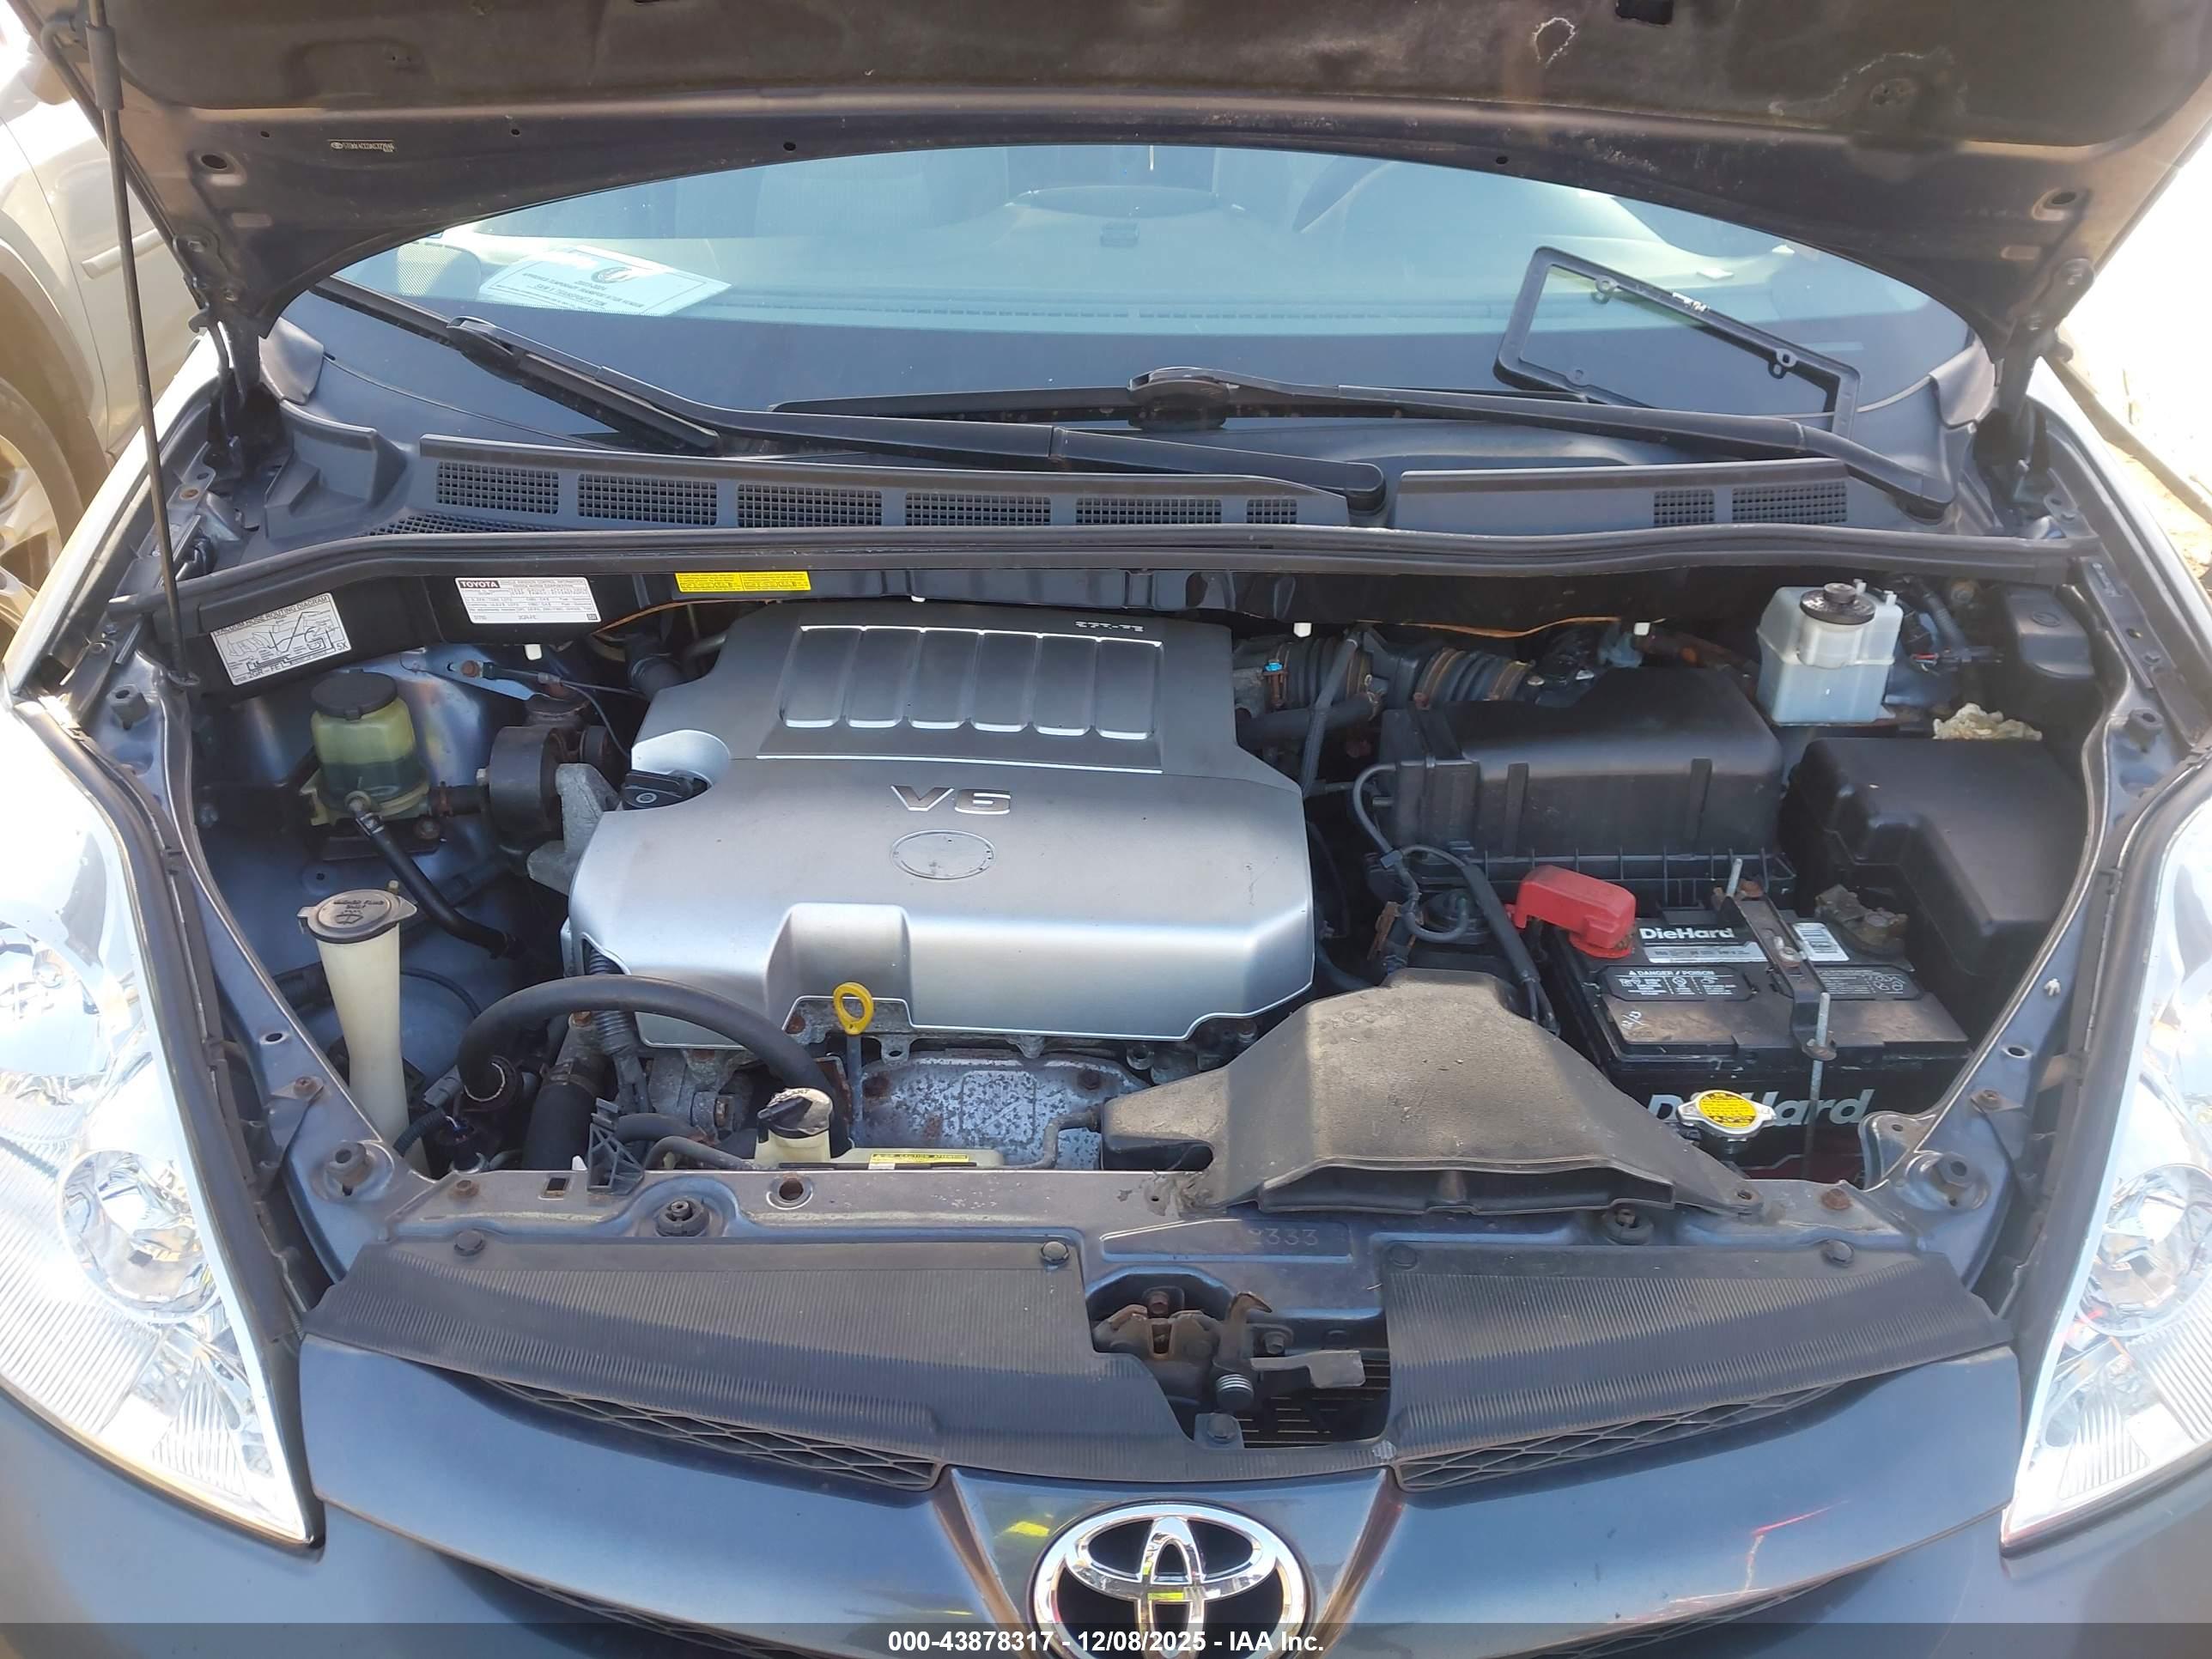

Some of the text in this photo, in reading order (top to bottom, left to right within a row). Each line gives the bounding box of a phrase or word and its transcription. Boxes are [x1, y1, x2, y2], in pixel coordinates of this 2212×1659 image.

[265, 605, 297, 620] ROUTING
[296, 595, 328, 611] DIAGRAM
[890, 785, 1012, 815] V6
[1638, 927, 1735, 939] DieHard
